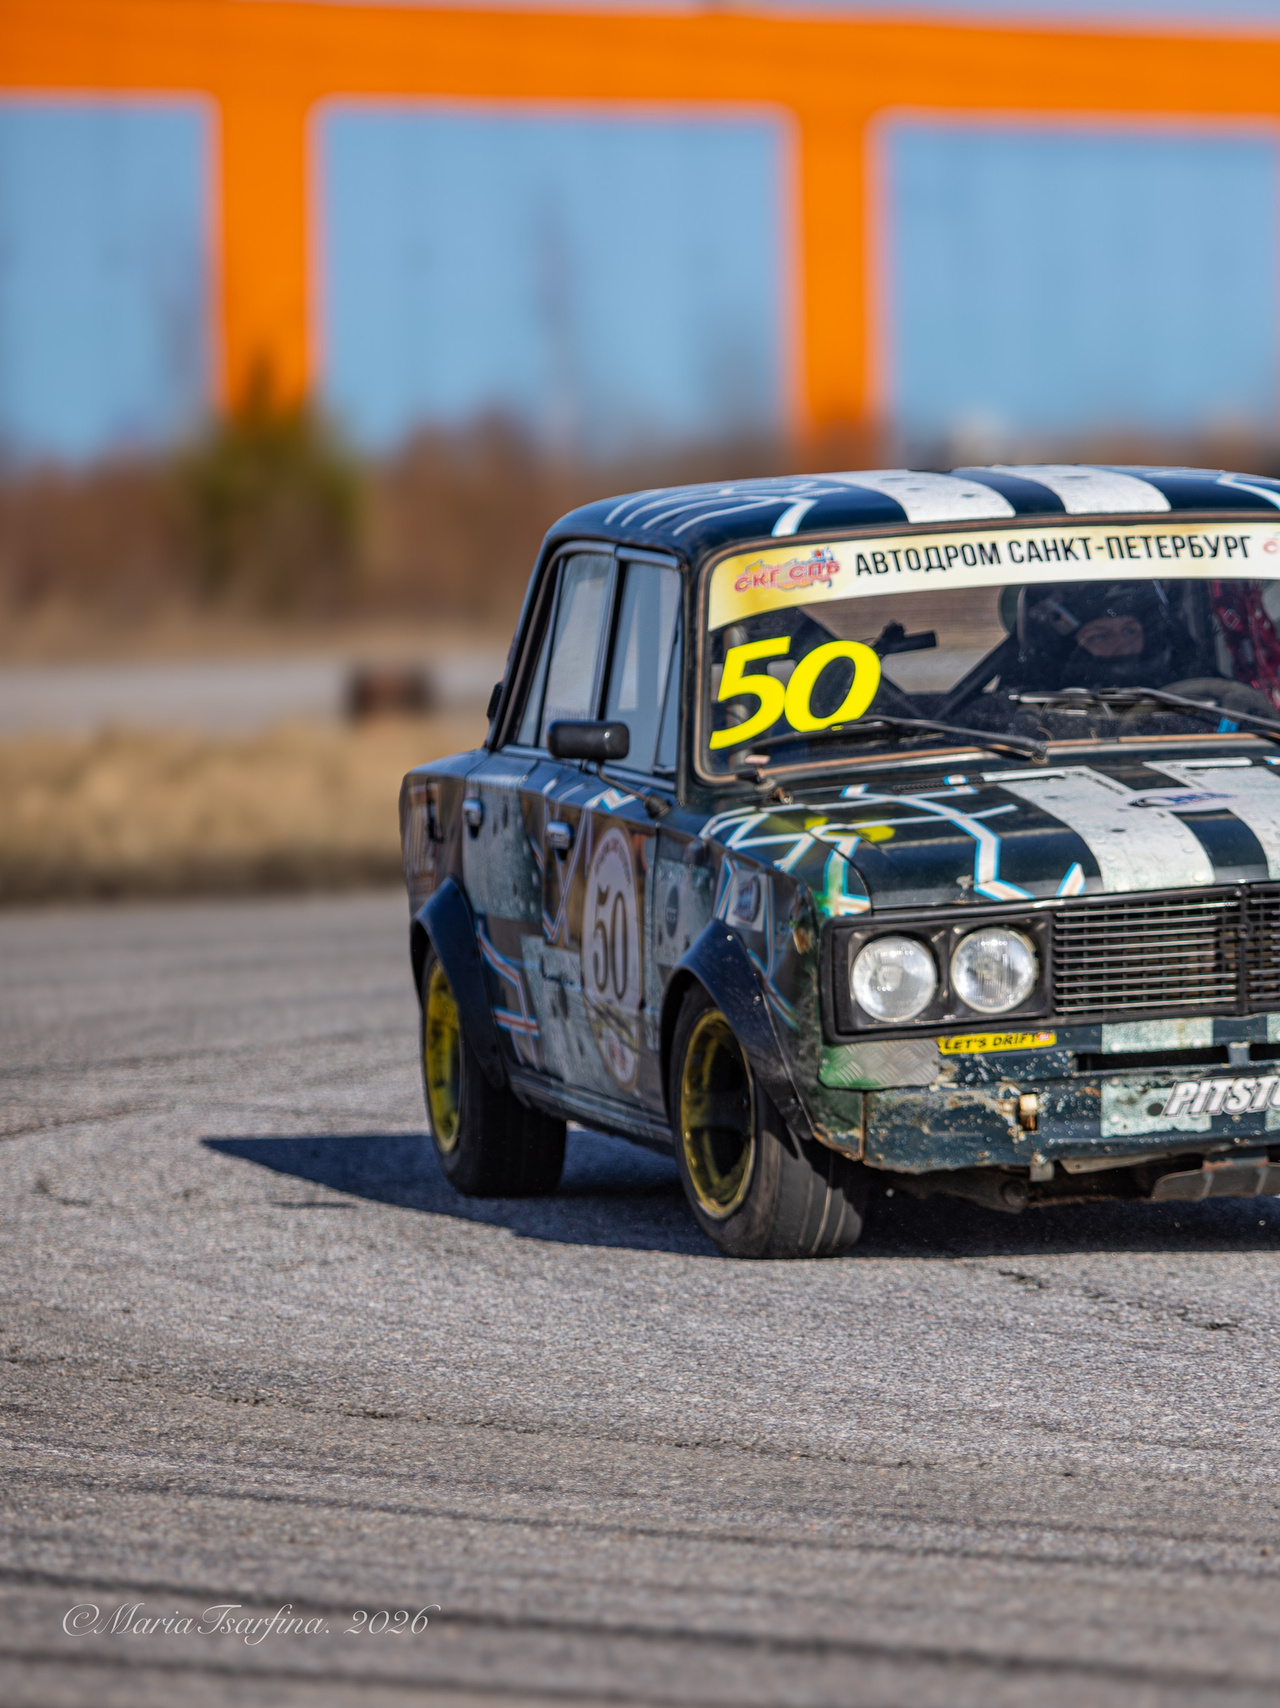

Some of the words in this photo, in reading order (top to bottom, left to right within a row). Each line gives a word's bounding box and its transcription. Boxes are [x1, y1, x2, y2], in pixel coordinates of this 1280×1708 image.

[856, 541, 1002, 577] АВТОДРОМ
[1008, 535, 1252, 565] САНКТ-ПЕТЕРБУРГ
[709, 636, 881, 750] 50
[593, 884, 628, 1000] 50
[944, 1037, 987, 1050] LET'S
[993, 1033, 1037, 1047] DRIFT
